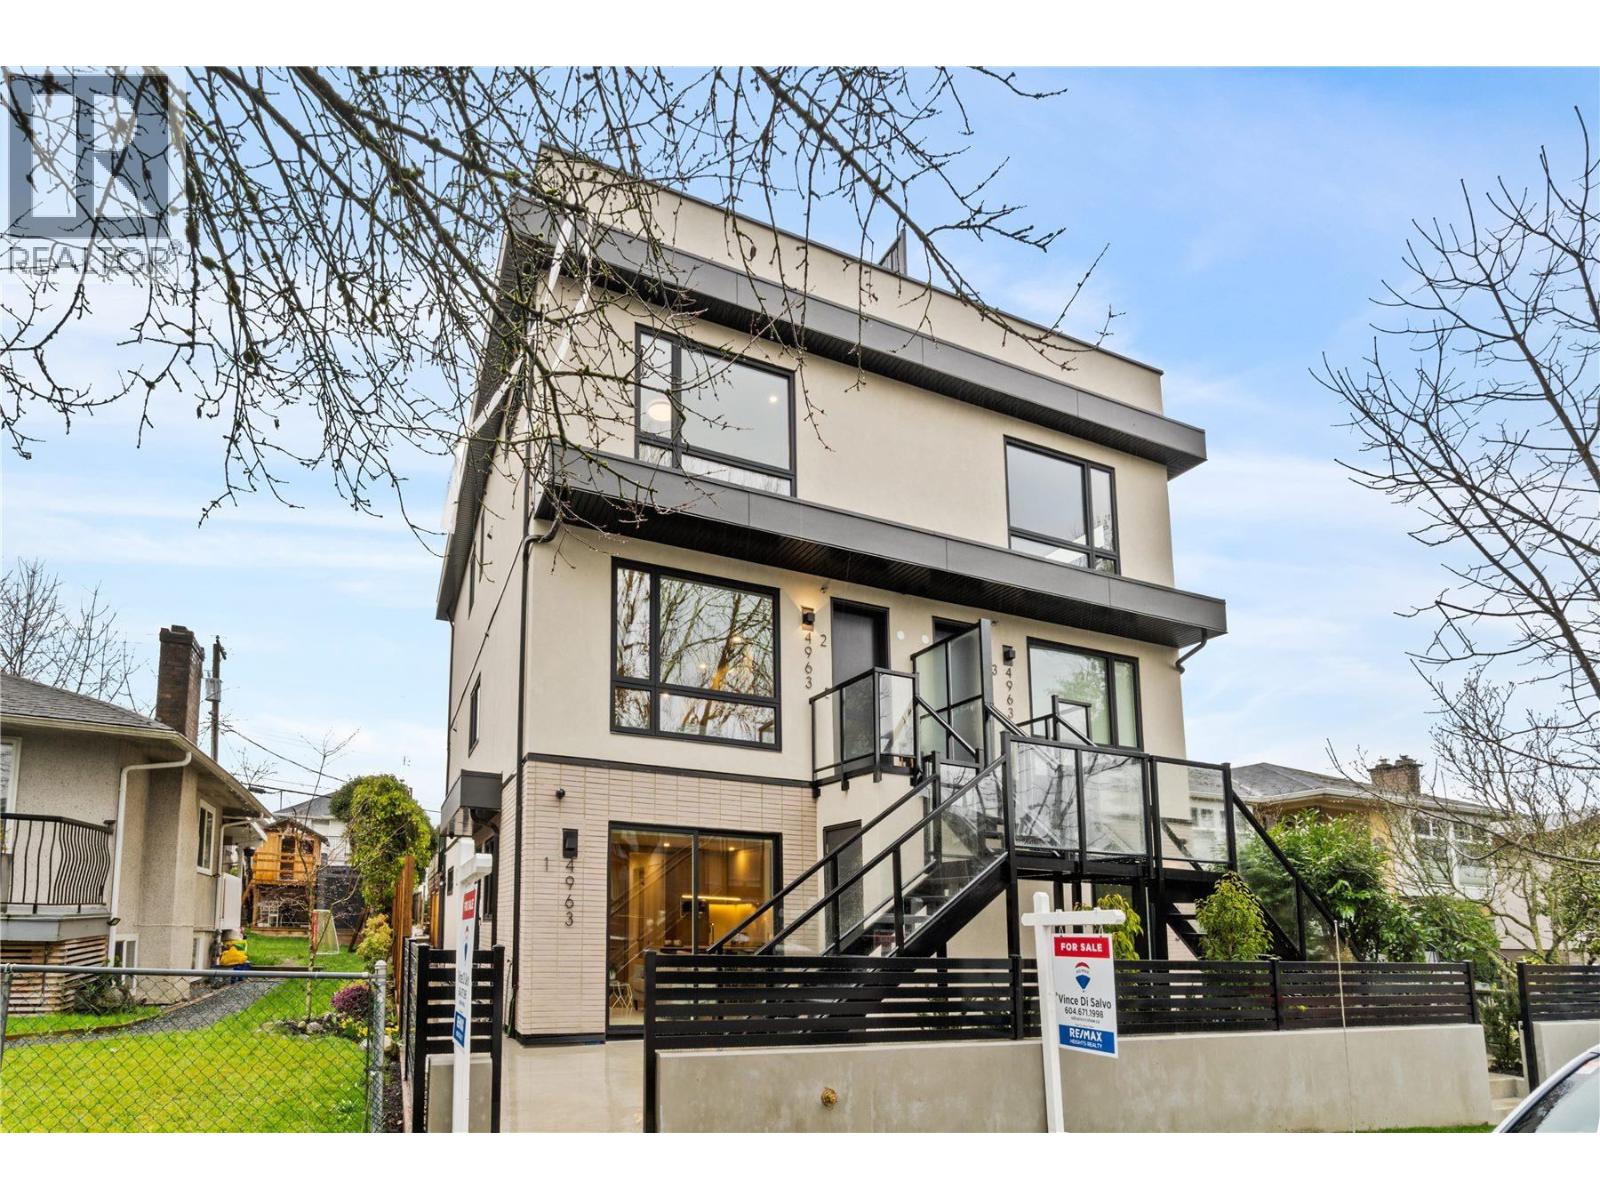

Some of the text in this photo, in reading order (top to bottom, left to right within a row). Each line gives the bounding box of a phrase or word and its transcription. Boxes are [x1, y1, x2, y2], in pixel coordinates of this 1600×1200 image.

[820, 634, 827, 647] 2
[804, 632, 813, 689] 4963
[992, 664, 998, 676] 3
[1005, 667, 1014, 719] 4963
[543, 856, 549, 872] 1
[565, 859, 575, 927] 4963
[1060, 942, 1103, 953] FOR SALE
[1080, 995, 1089, 1006] Di
[1090, 997, 1112, 1010] Salvo
[1064, 1006, 1104, 1019] 604.671.1998
[1069, 1027, 1103, 1043] RE/MAX
